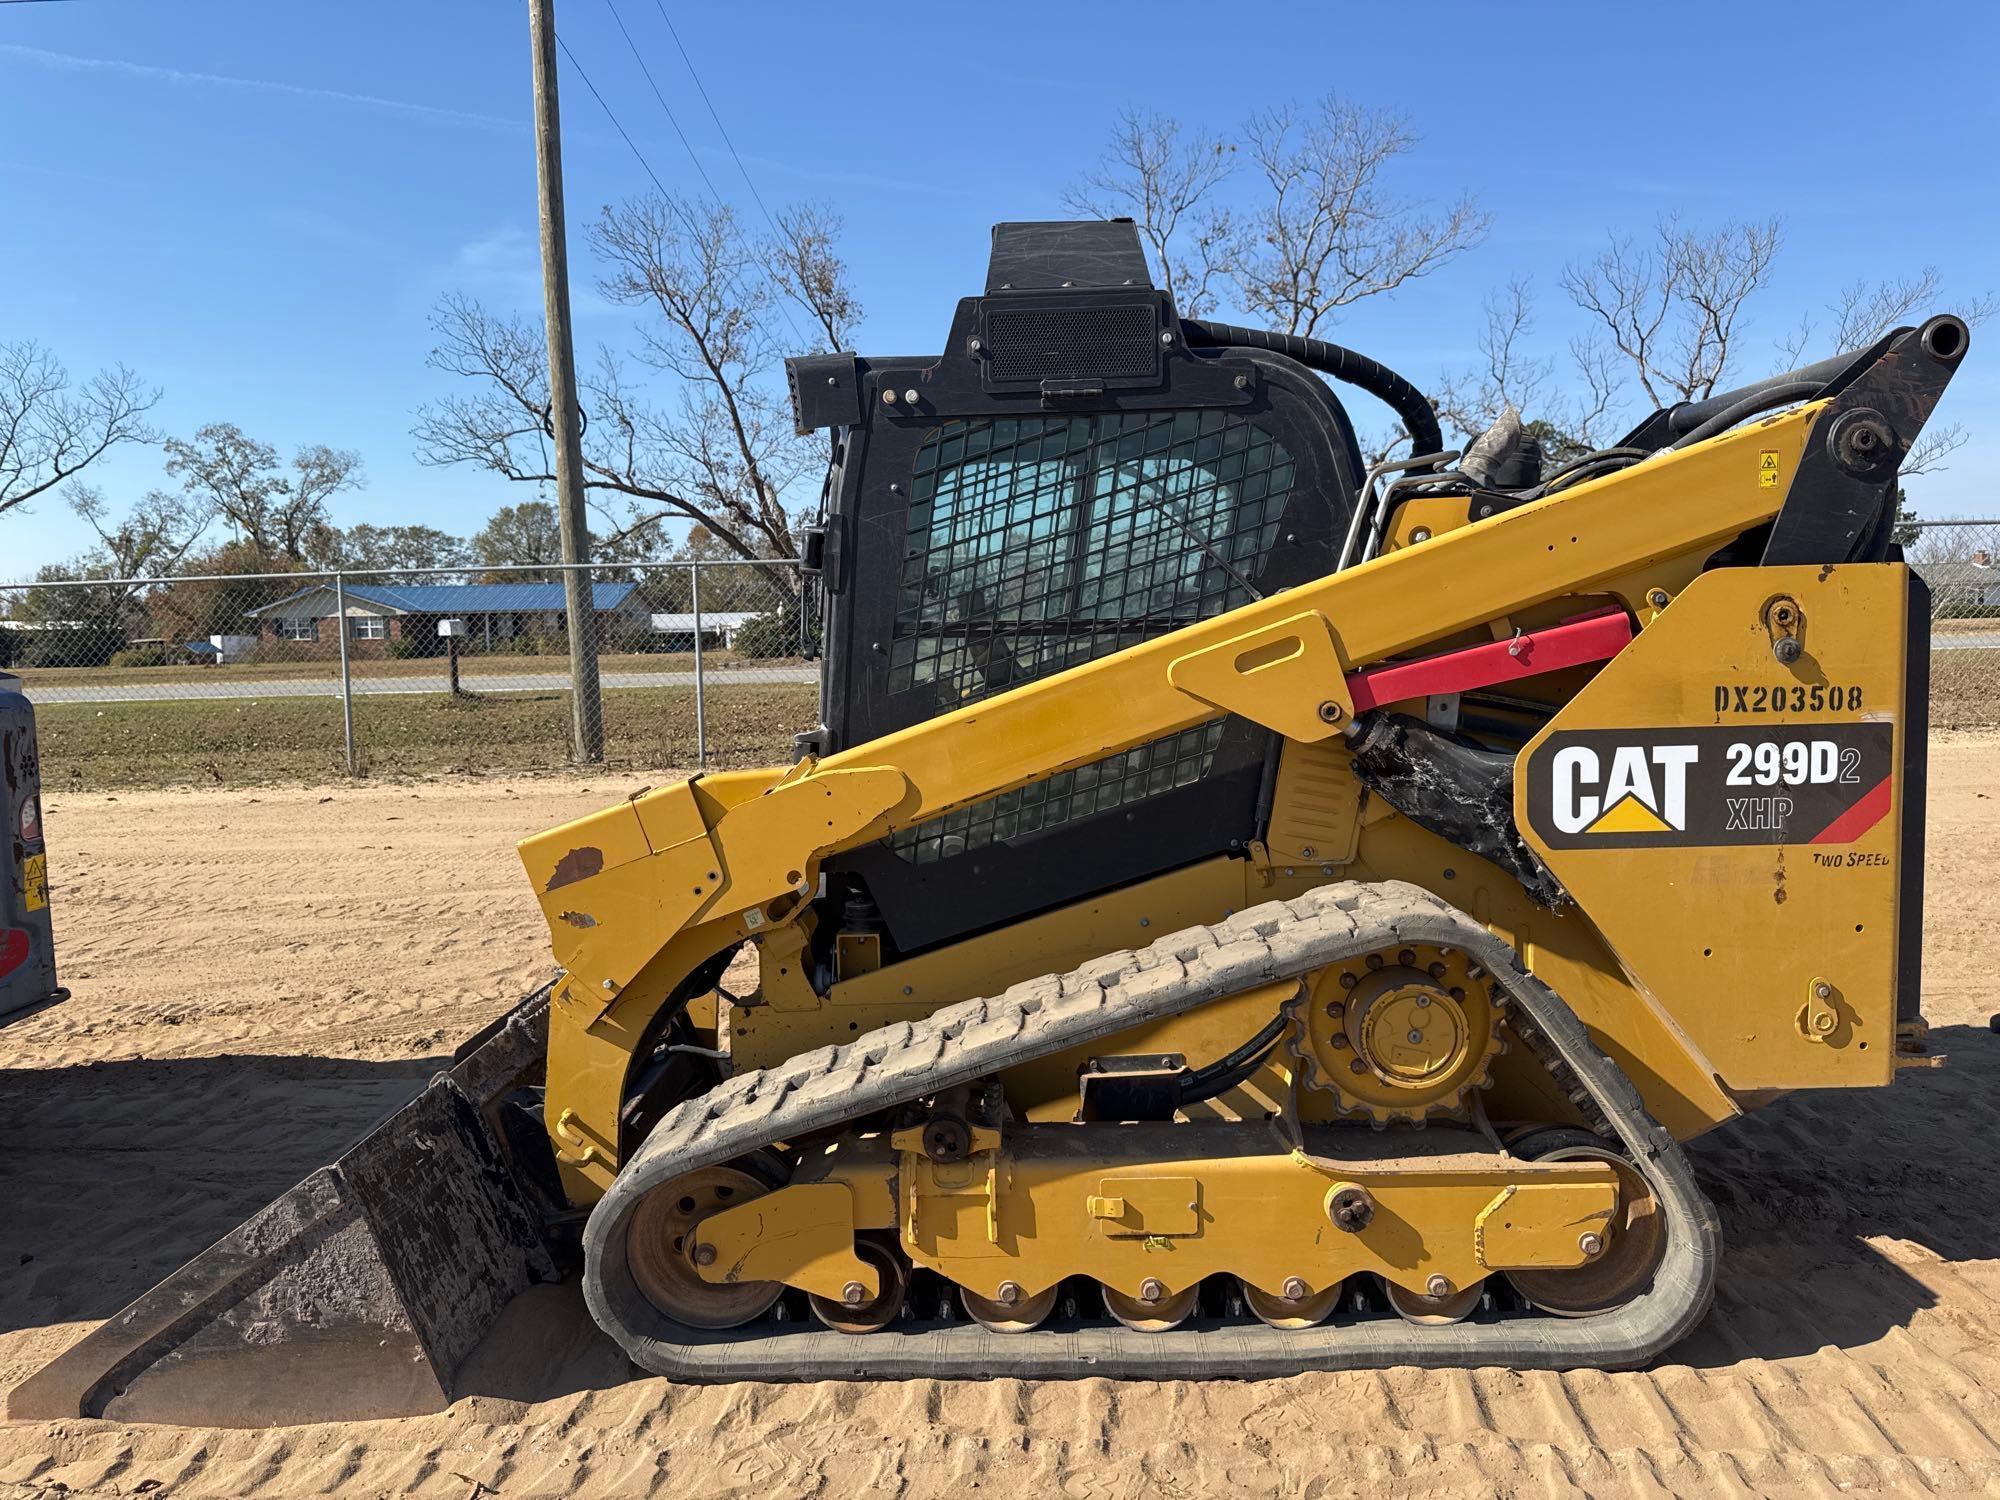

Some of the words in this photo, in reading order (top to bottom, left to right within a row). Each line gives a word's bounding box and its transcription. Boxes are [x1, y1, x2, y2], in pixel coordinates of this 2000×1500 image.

[1715, 686, 1862, 712] DX203508
[1726, 741, 1861, 785] 299D2
[1553, 745, 1698, 833] CAT
[1726, 797, 1793, 830] XHP
[1813, 853, 1843, 867] TWO
